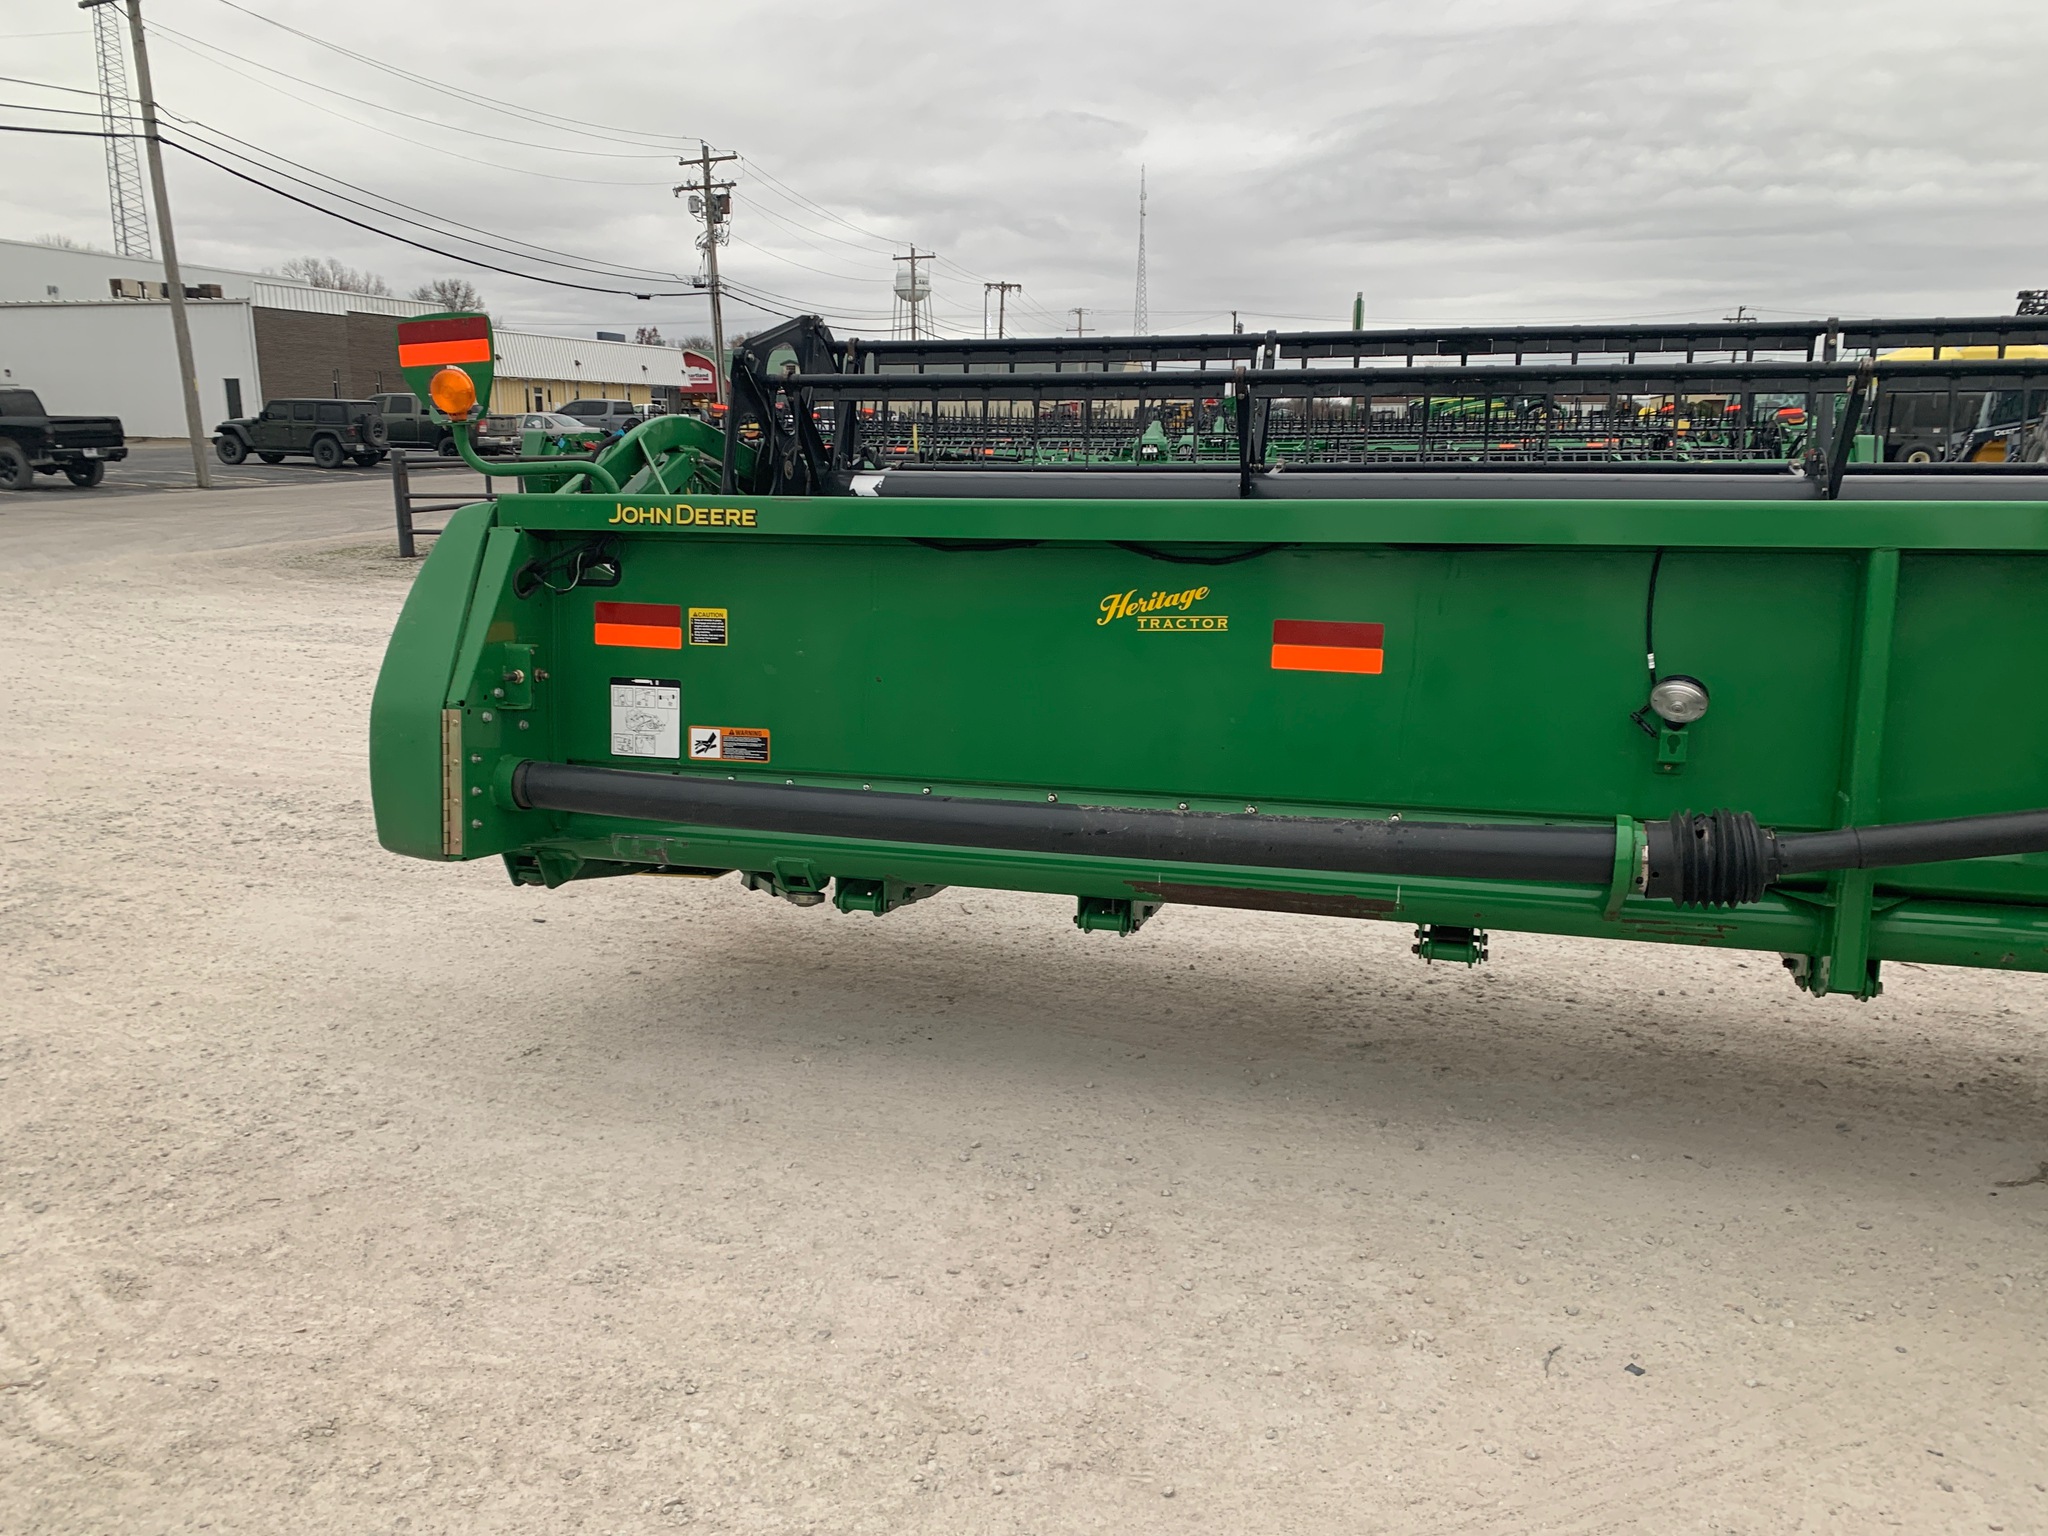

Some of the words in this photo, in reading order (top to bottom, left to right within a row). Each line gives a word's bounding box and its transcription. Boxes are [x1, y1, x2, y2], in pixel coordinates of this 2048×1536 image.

[608, 503, 672, 525] JOHN
[676, 504, 757, 527] DEERE
[1096, 586, 1210, 625] Heritage
[1137, 618, 1228, 629] TRACTOR
